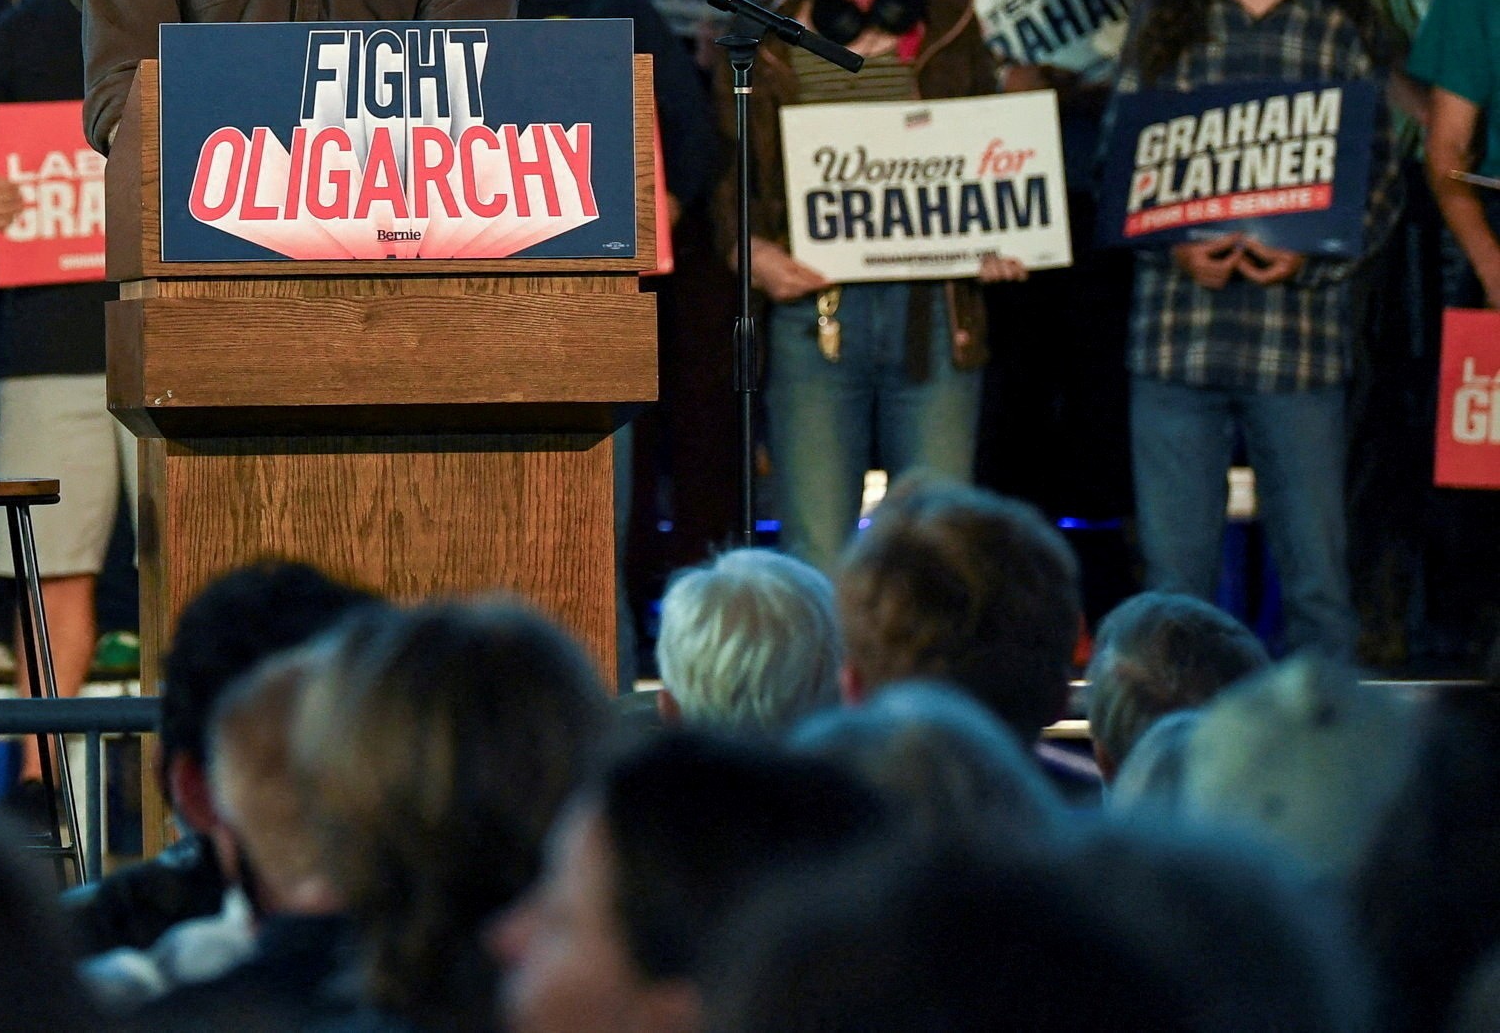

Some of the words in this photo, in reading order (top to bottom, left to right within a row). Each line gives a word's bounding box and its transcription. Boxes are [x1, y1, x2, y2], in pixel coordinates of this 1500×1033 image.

[300, 28, 488, 120] FIGHT
[814, 145, 965, 184] Women
[977, 138, 1037, 177] for
[1135, 87, 1343, 166] GRAHAM
[7, 149, 105, 183] LAB
[188, 123, 600, 222] OLIGARCHY
[1126, 135, 1337, 214] PLATNER
[7, 180, 105, 241] GRA
[377, 229, 421, 241] Bernie
[807, 173, 1050, 242] GRAHAM
